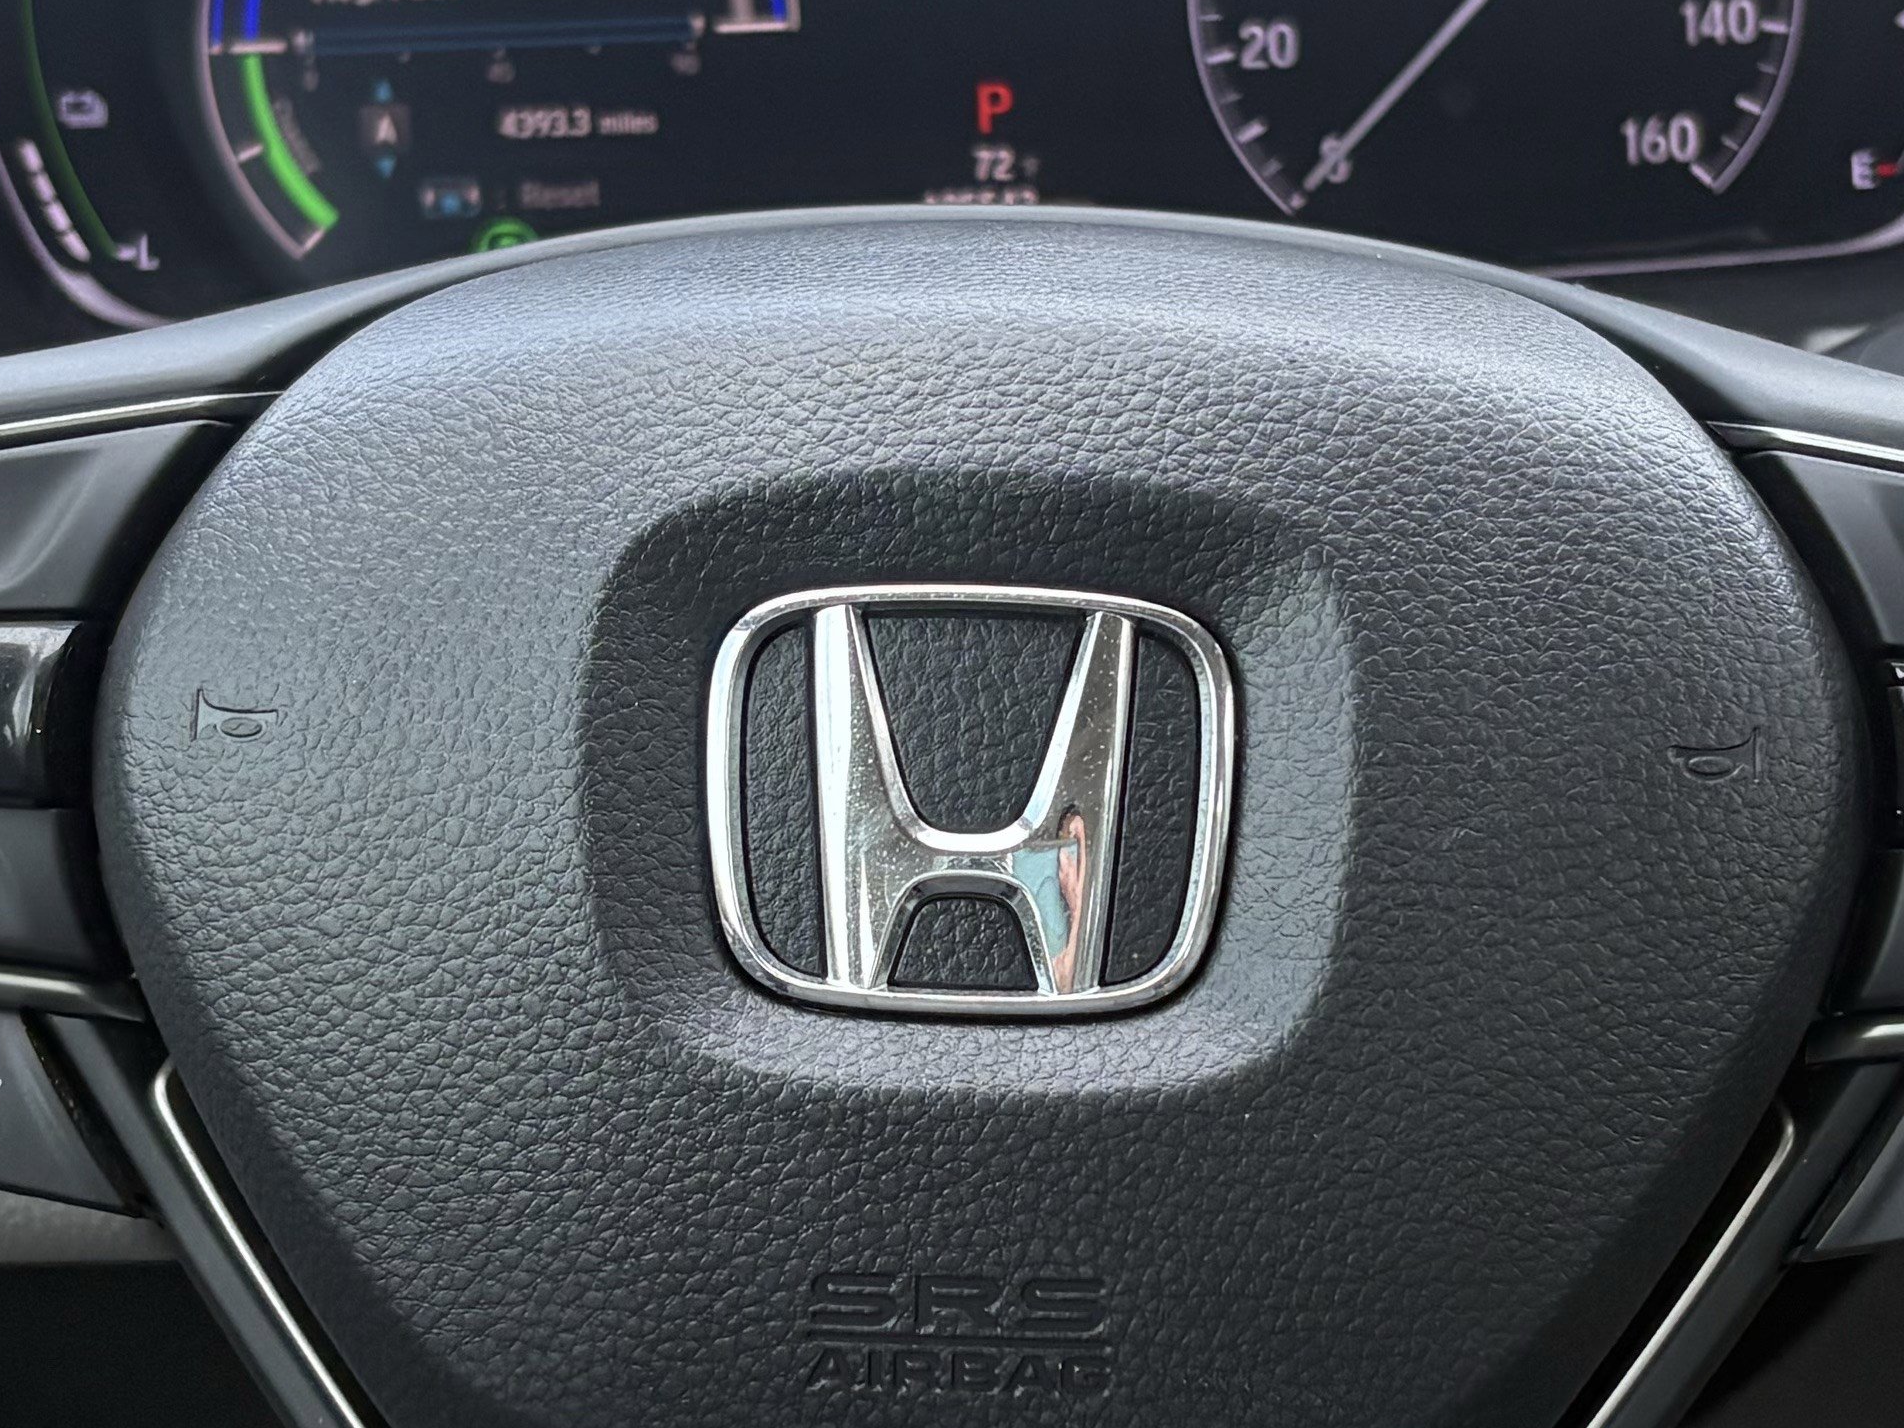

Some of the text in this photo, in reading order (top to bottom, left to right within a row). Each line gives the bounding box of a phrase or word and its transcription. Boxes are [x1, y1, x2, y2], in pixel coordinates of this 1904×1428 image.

[1238, 21, 1299, 71] 20
[599, 110, 661, 136] miles
[976, 82, 1014, 134] P
[972, 144, 1015, 181] 72
[1620, 111, 1701, 166] 160
[1851, 147, 1877, 191] E
[807, 1273, 1108, 1339] SRS
[802, 1349, 1111, 1395] AIRBAG
